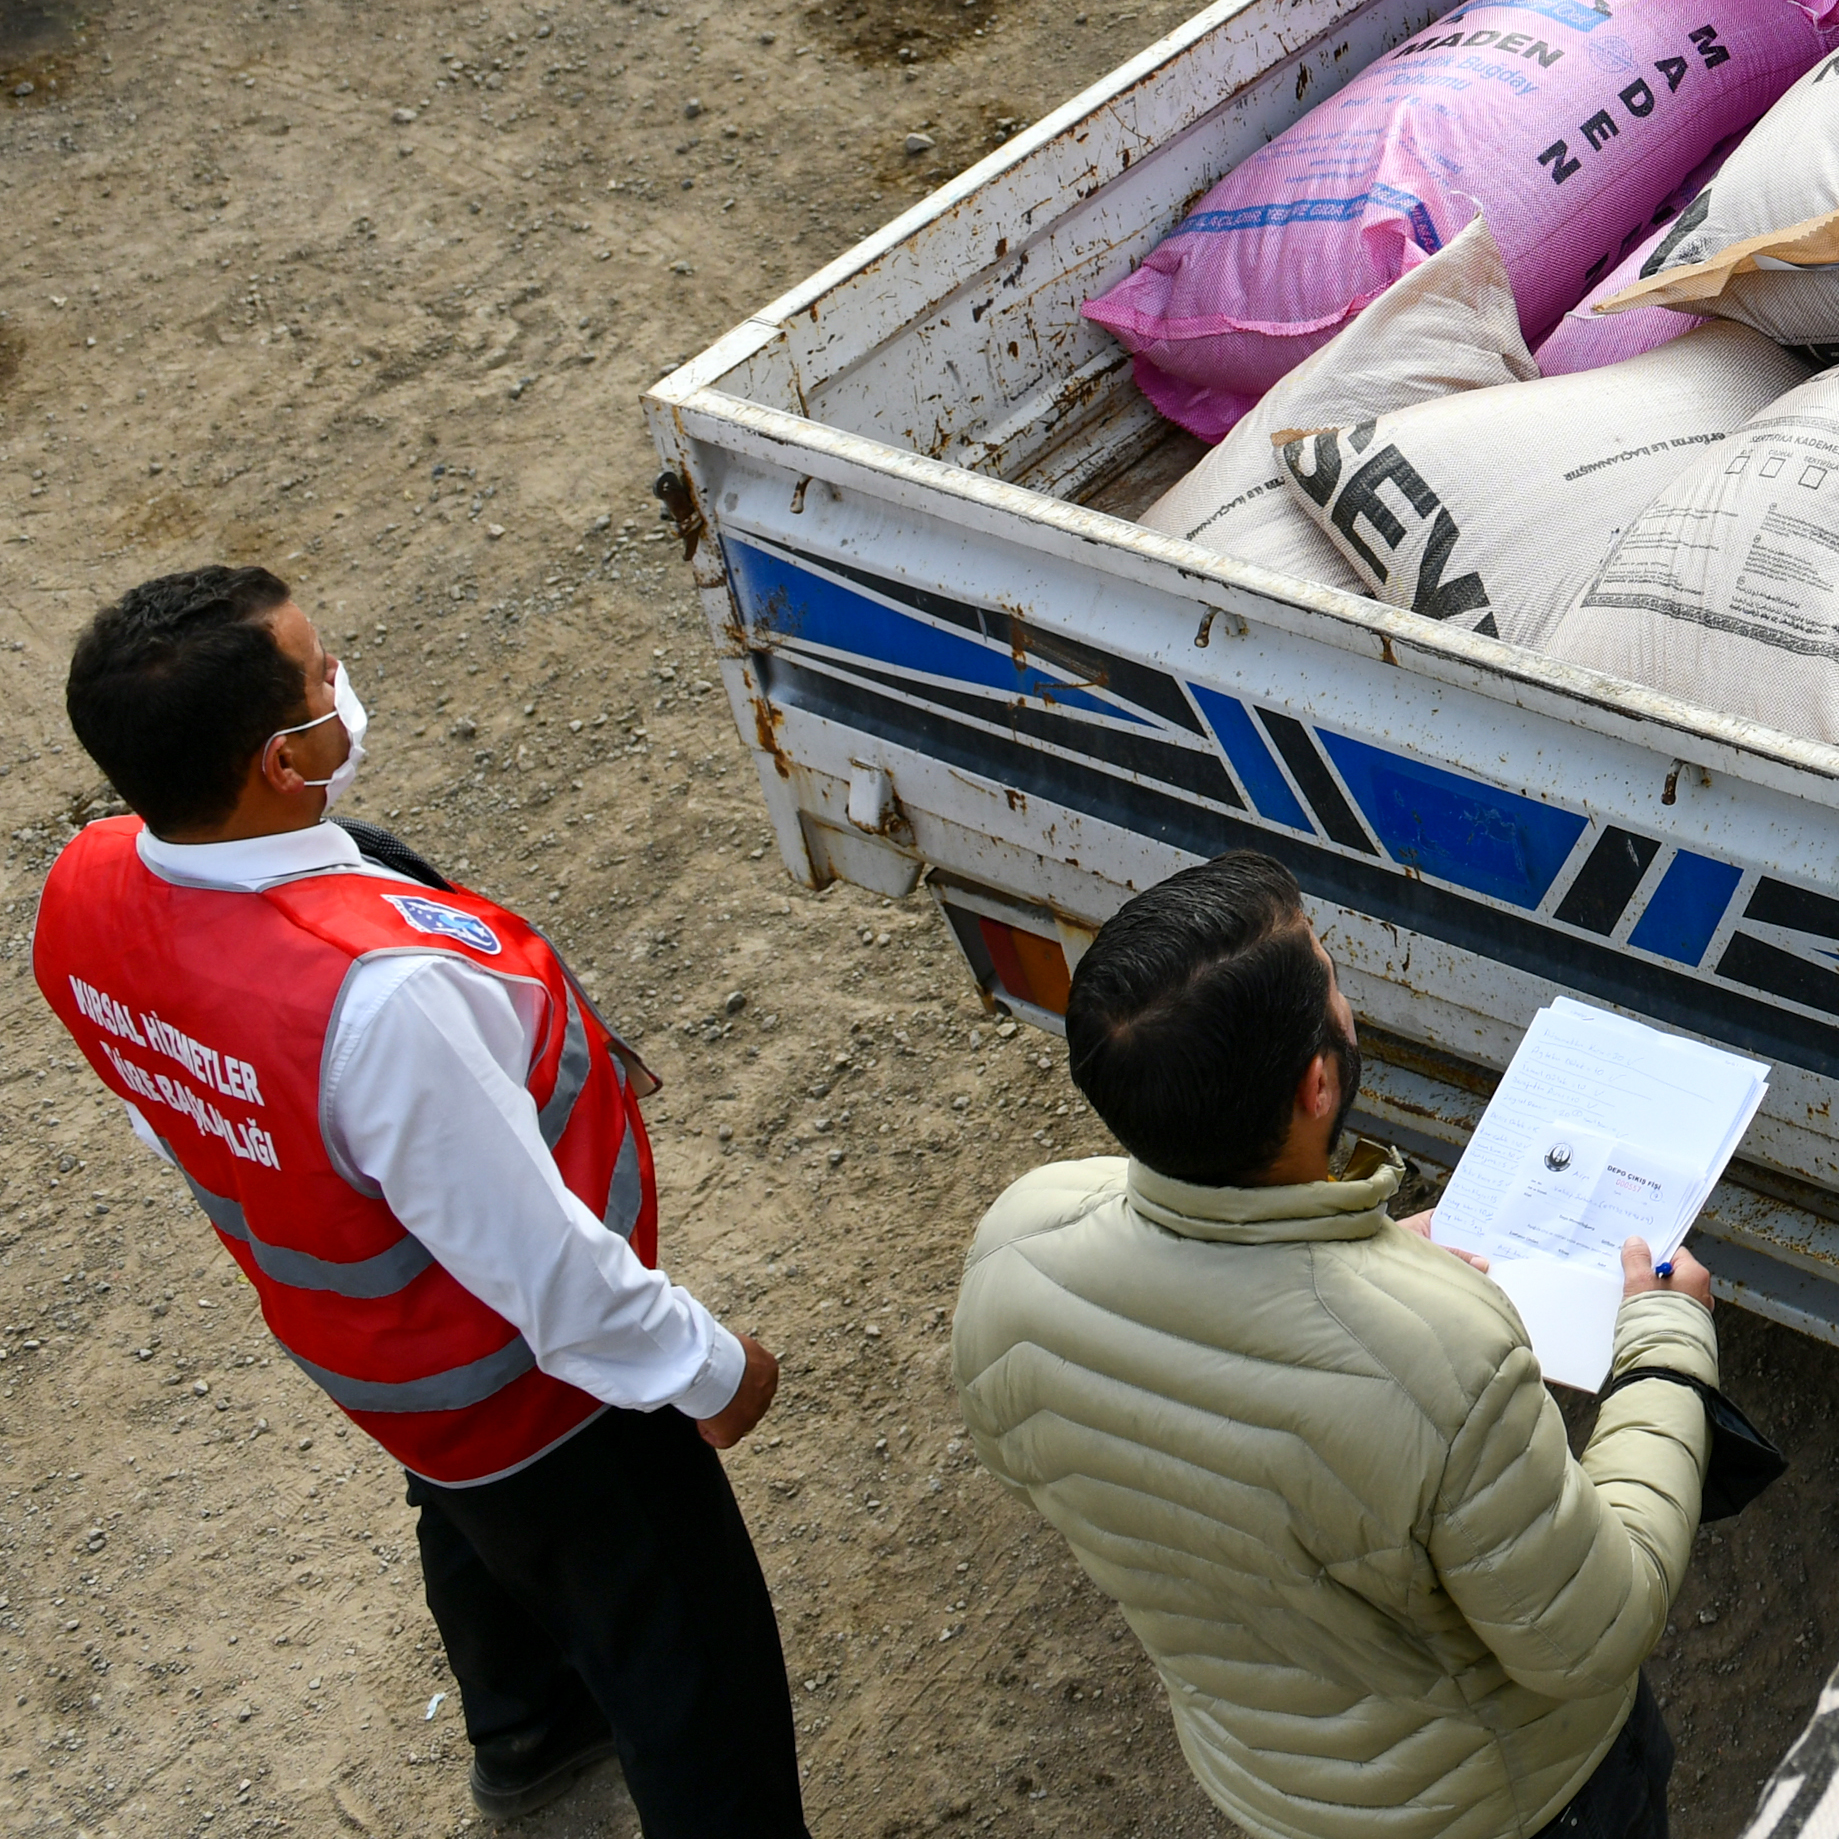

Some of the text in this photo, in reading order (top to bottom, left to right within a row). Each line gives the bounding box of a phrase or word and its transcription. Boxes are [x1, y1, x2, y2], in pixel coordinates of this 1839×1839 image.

[1391, 29, 1566, 70] MADEN
[1458, 55, 1539, 96] Buğday
[1536, 23, 1732, 186] MADEN
[69, 973, 266, 1108] KIRSAL HİZMETLER
[1606, 1163, 1663, 1191] DEPO ÇIKIŞ FİŞİ
[1615, 1178, 1643, 1193] 000557
